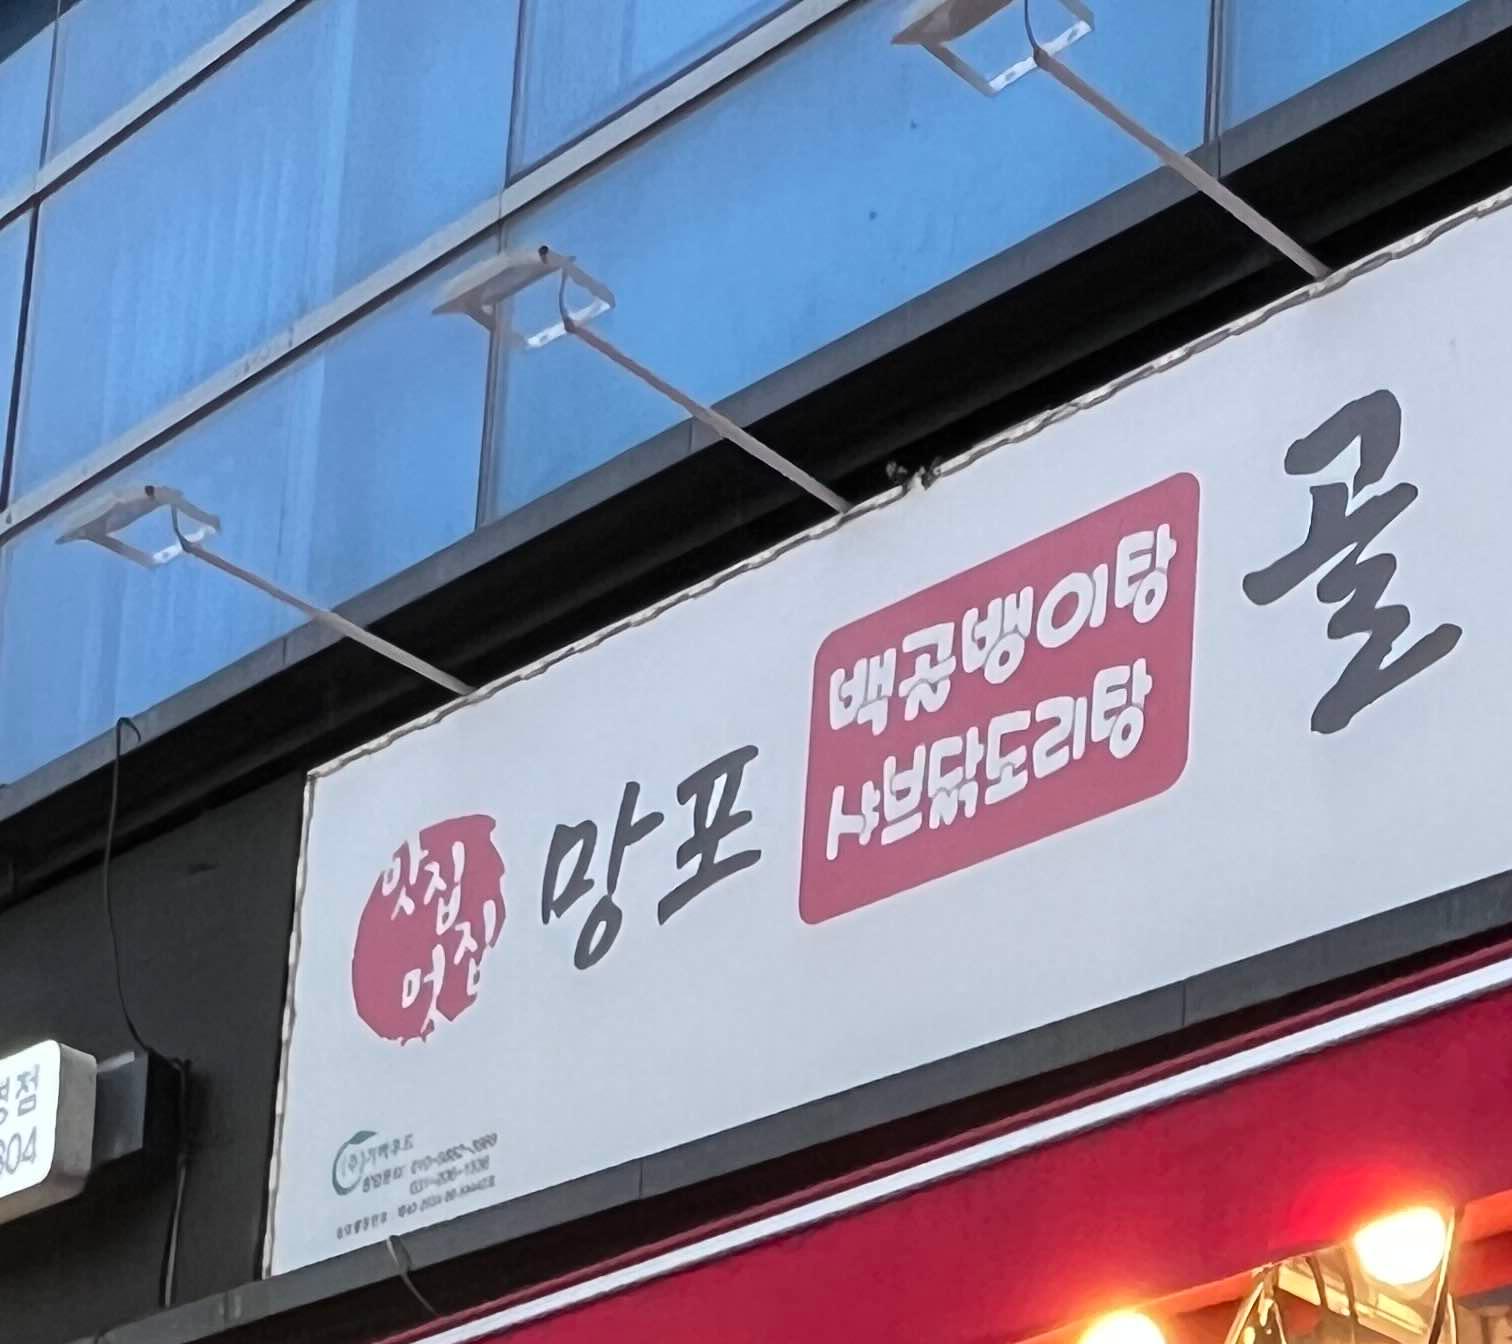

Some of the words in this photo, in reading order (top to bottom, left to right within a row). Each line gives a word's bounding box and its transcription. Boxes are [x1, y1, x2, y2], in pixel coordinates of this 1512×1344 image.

[828, 522, 1177, 736] 백골뱅이탕
[540, 744, 763, 972] 망포
[825, 658, 1153, 861] 샤브닭도리탕
